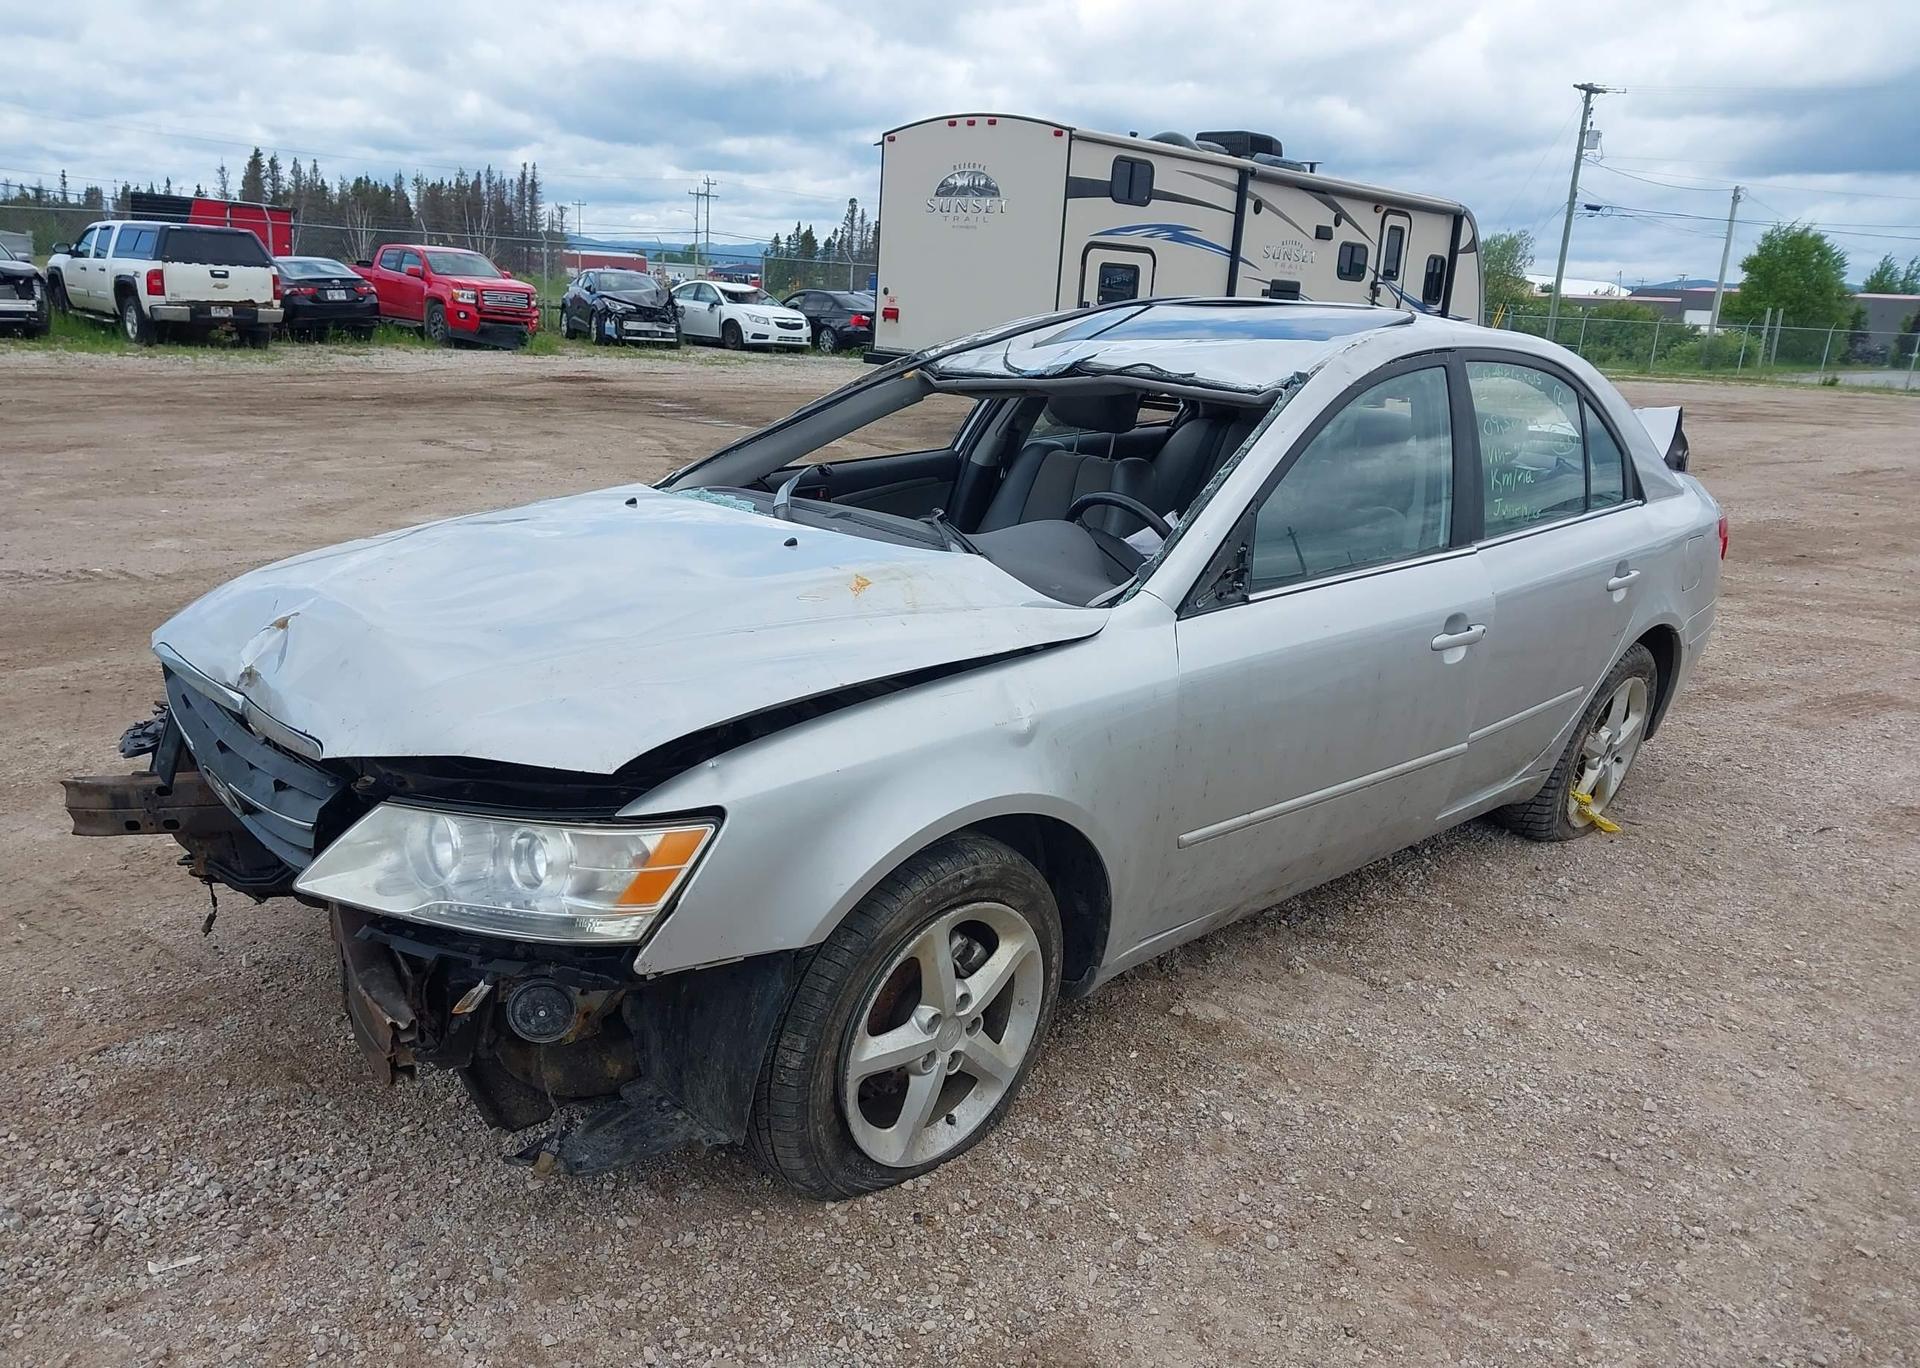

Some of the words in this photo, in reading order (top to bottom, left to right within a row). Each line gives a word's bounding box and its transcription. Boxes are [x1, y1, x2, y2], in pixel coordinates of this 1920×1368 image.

[926, 198, 1010, 215] SUNSET
[943, 215, 989, 224] TRAIL
[1262, 245, 1318, 264] SUNSET
